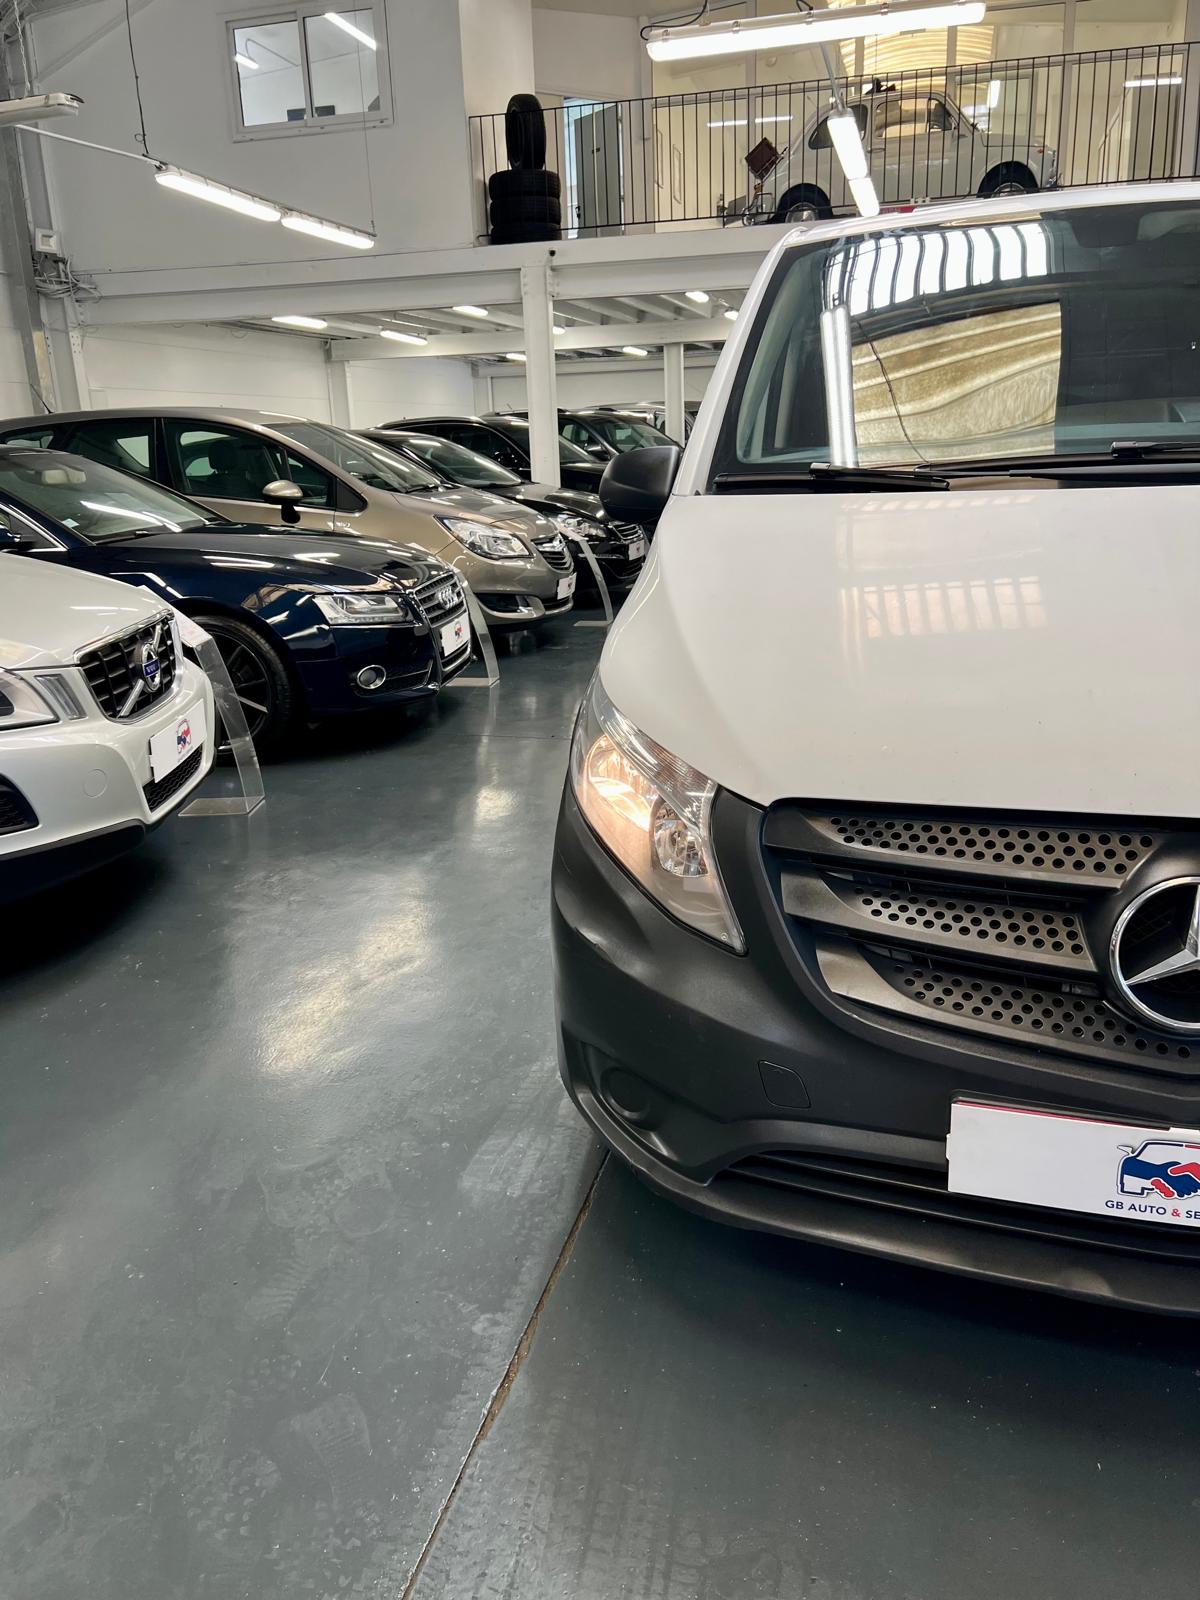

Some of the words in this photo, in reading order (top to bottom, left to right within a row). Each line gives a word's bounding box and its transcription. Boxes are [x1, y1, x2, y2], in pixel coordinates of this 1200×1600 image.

[1105, 1200, 1124, 1209] GB
[1128, 1203, 1166, 1215] AUTO
[1171, 1208, 1181, 1217] &
